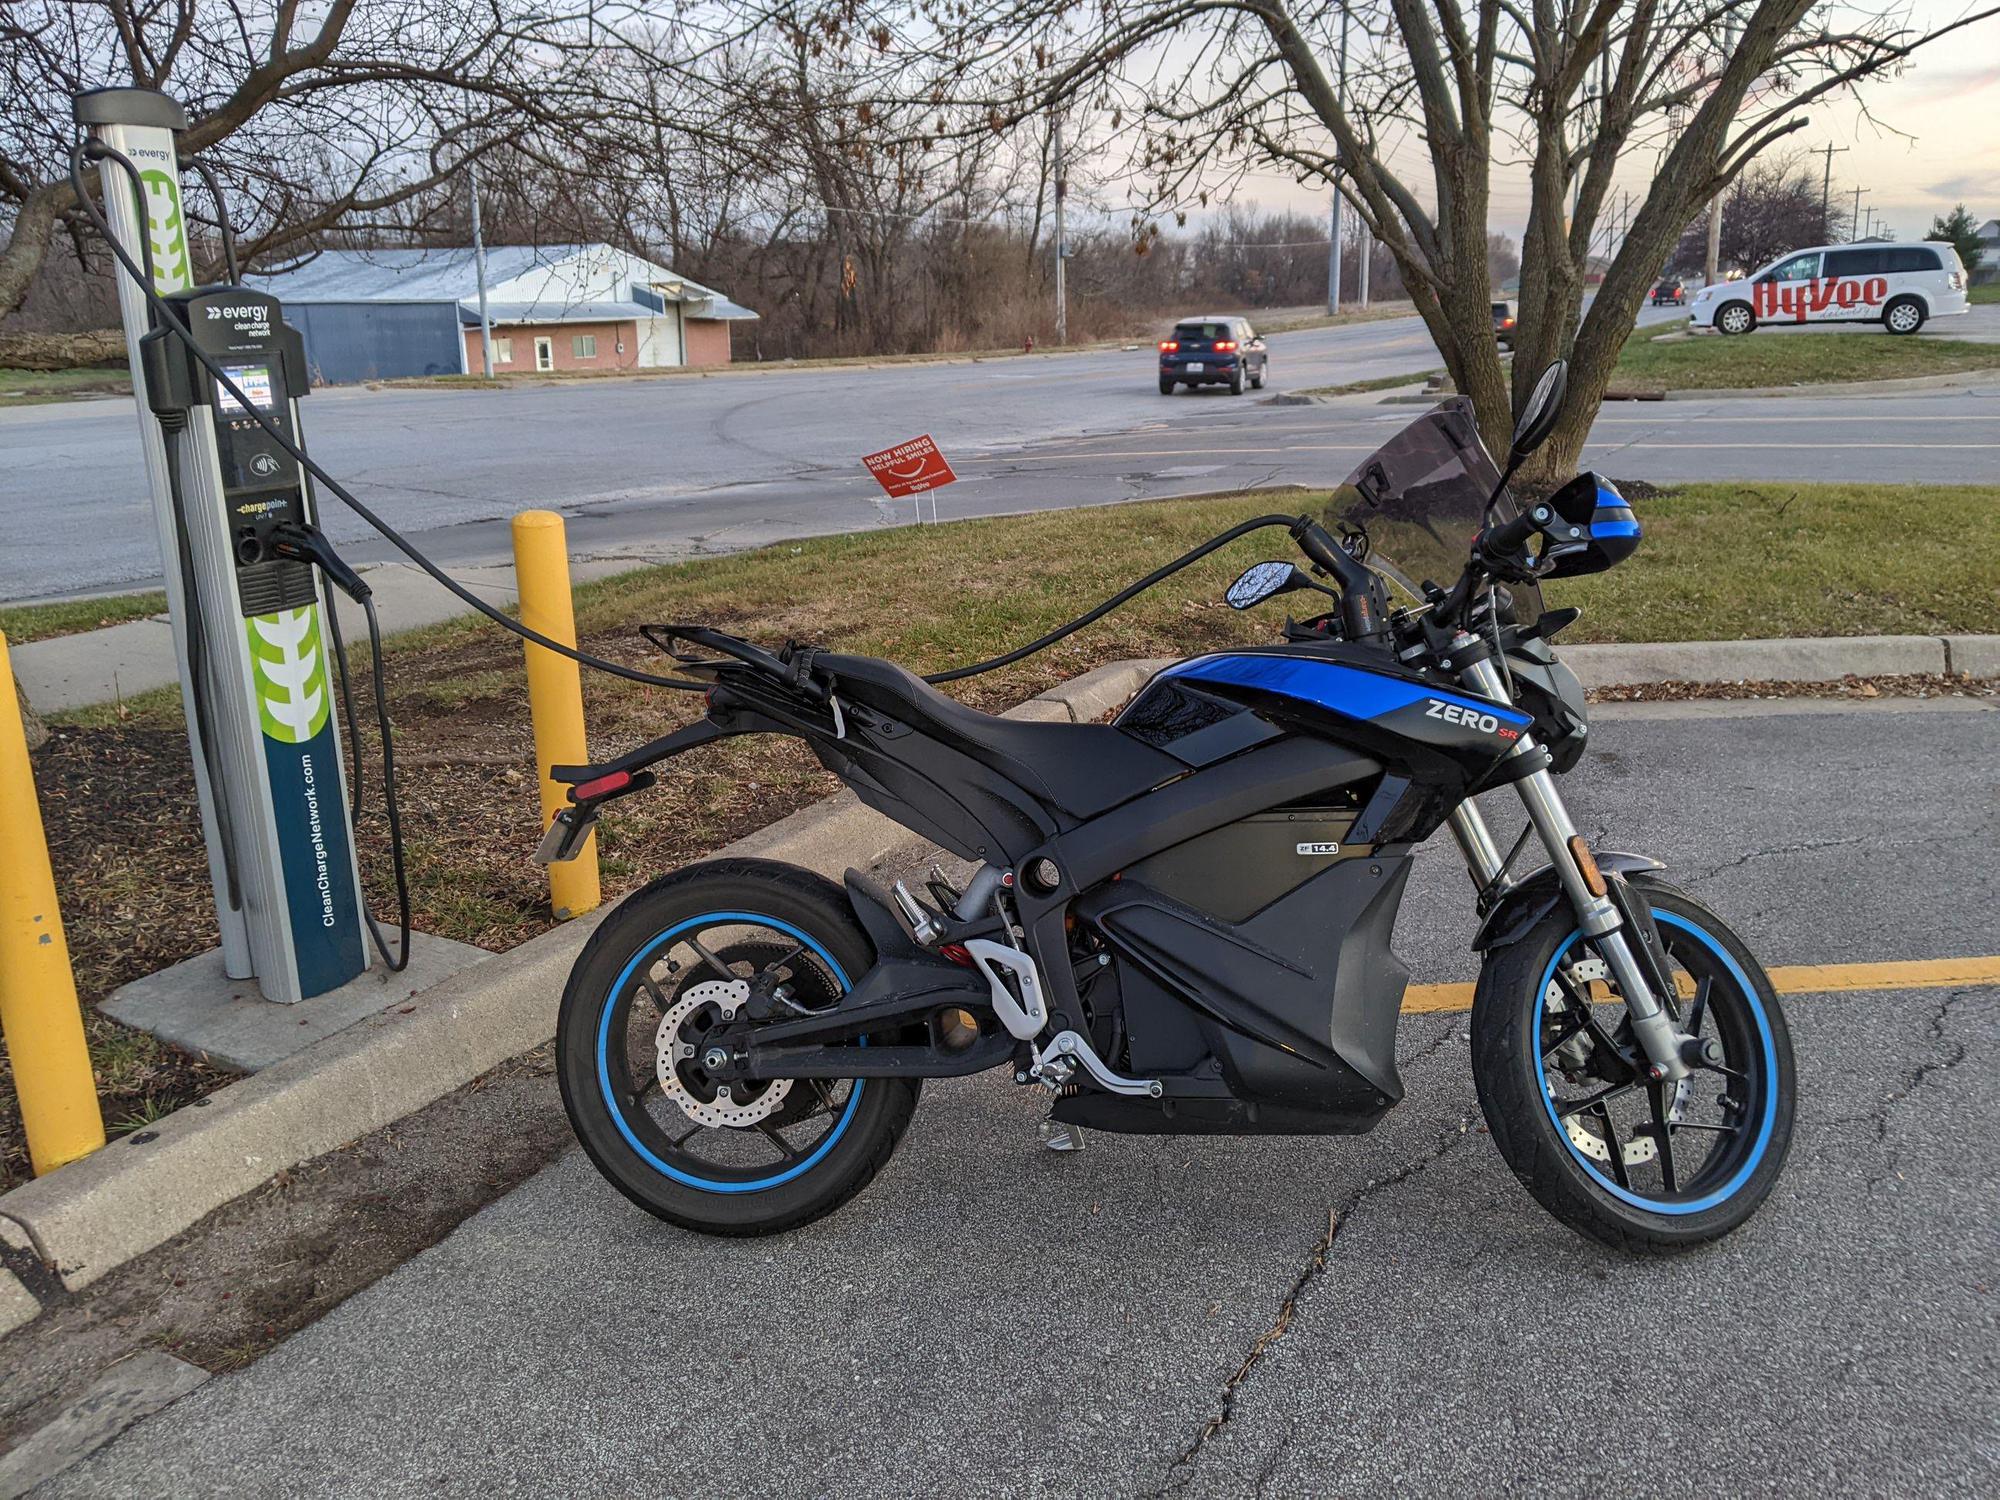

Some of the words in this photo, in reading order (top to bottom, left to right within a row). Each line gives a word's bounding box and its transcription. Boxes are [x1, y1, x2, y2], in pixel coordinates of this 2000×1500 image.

[138, 149, 170, 161] evergy
[222, 305, 268, 321] evergy
[234, 322, 251, 330] clean
[251, 321, 270, 330] charge
[248, 329, 271, 337] network
[866, 452, 892, 466] NOW
[893, 438, 931, 457] HIRING
[871, 457, 906, 472] HELPFUL
[906, 445, 935, 461] SMILES
[1425, 699, 1499, 734] ZERO
[1498, 728, 1519, 740] SR
[301, 754, 335, 927] CleanChargeNetwork.com
